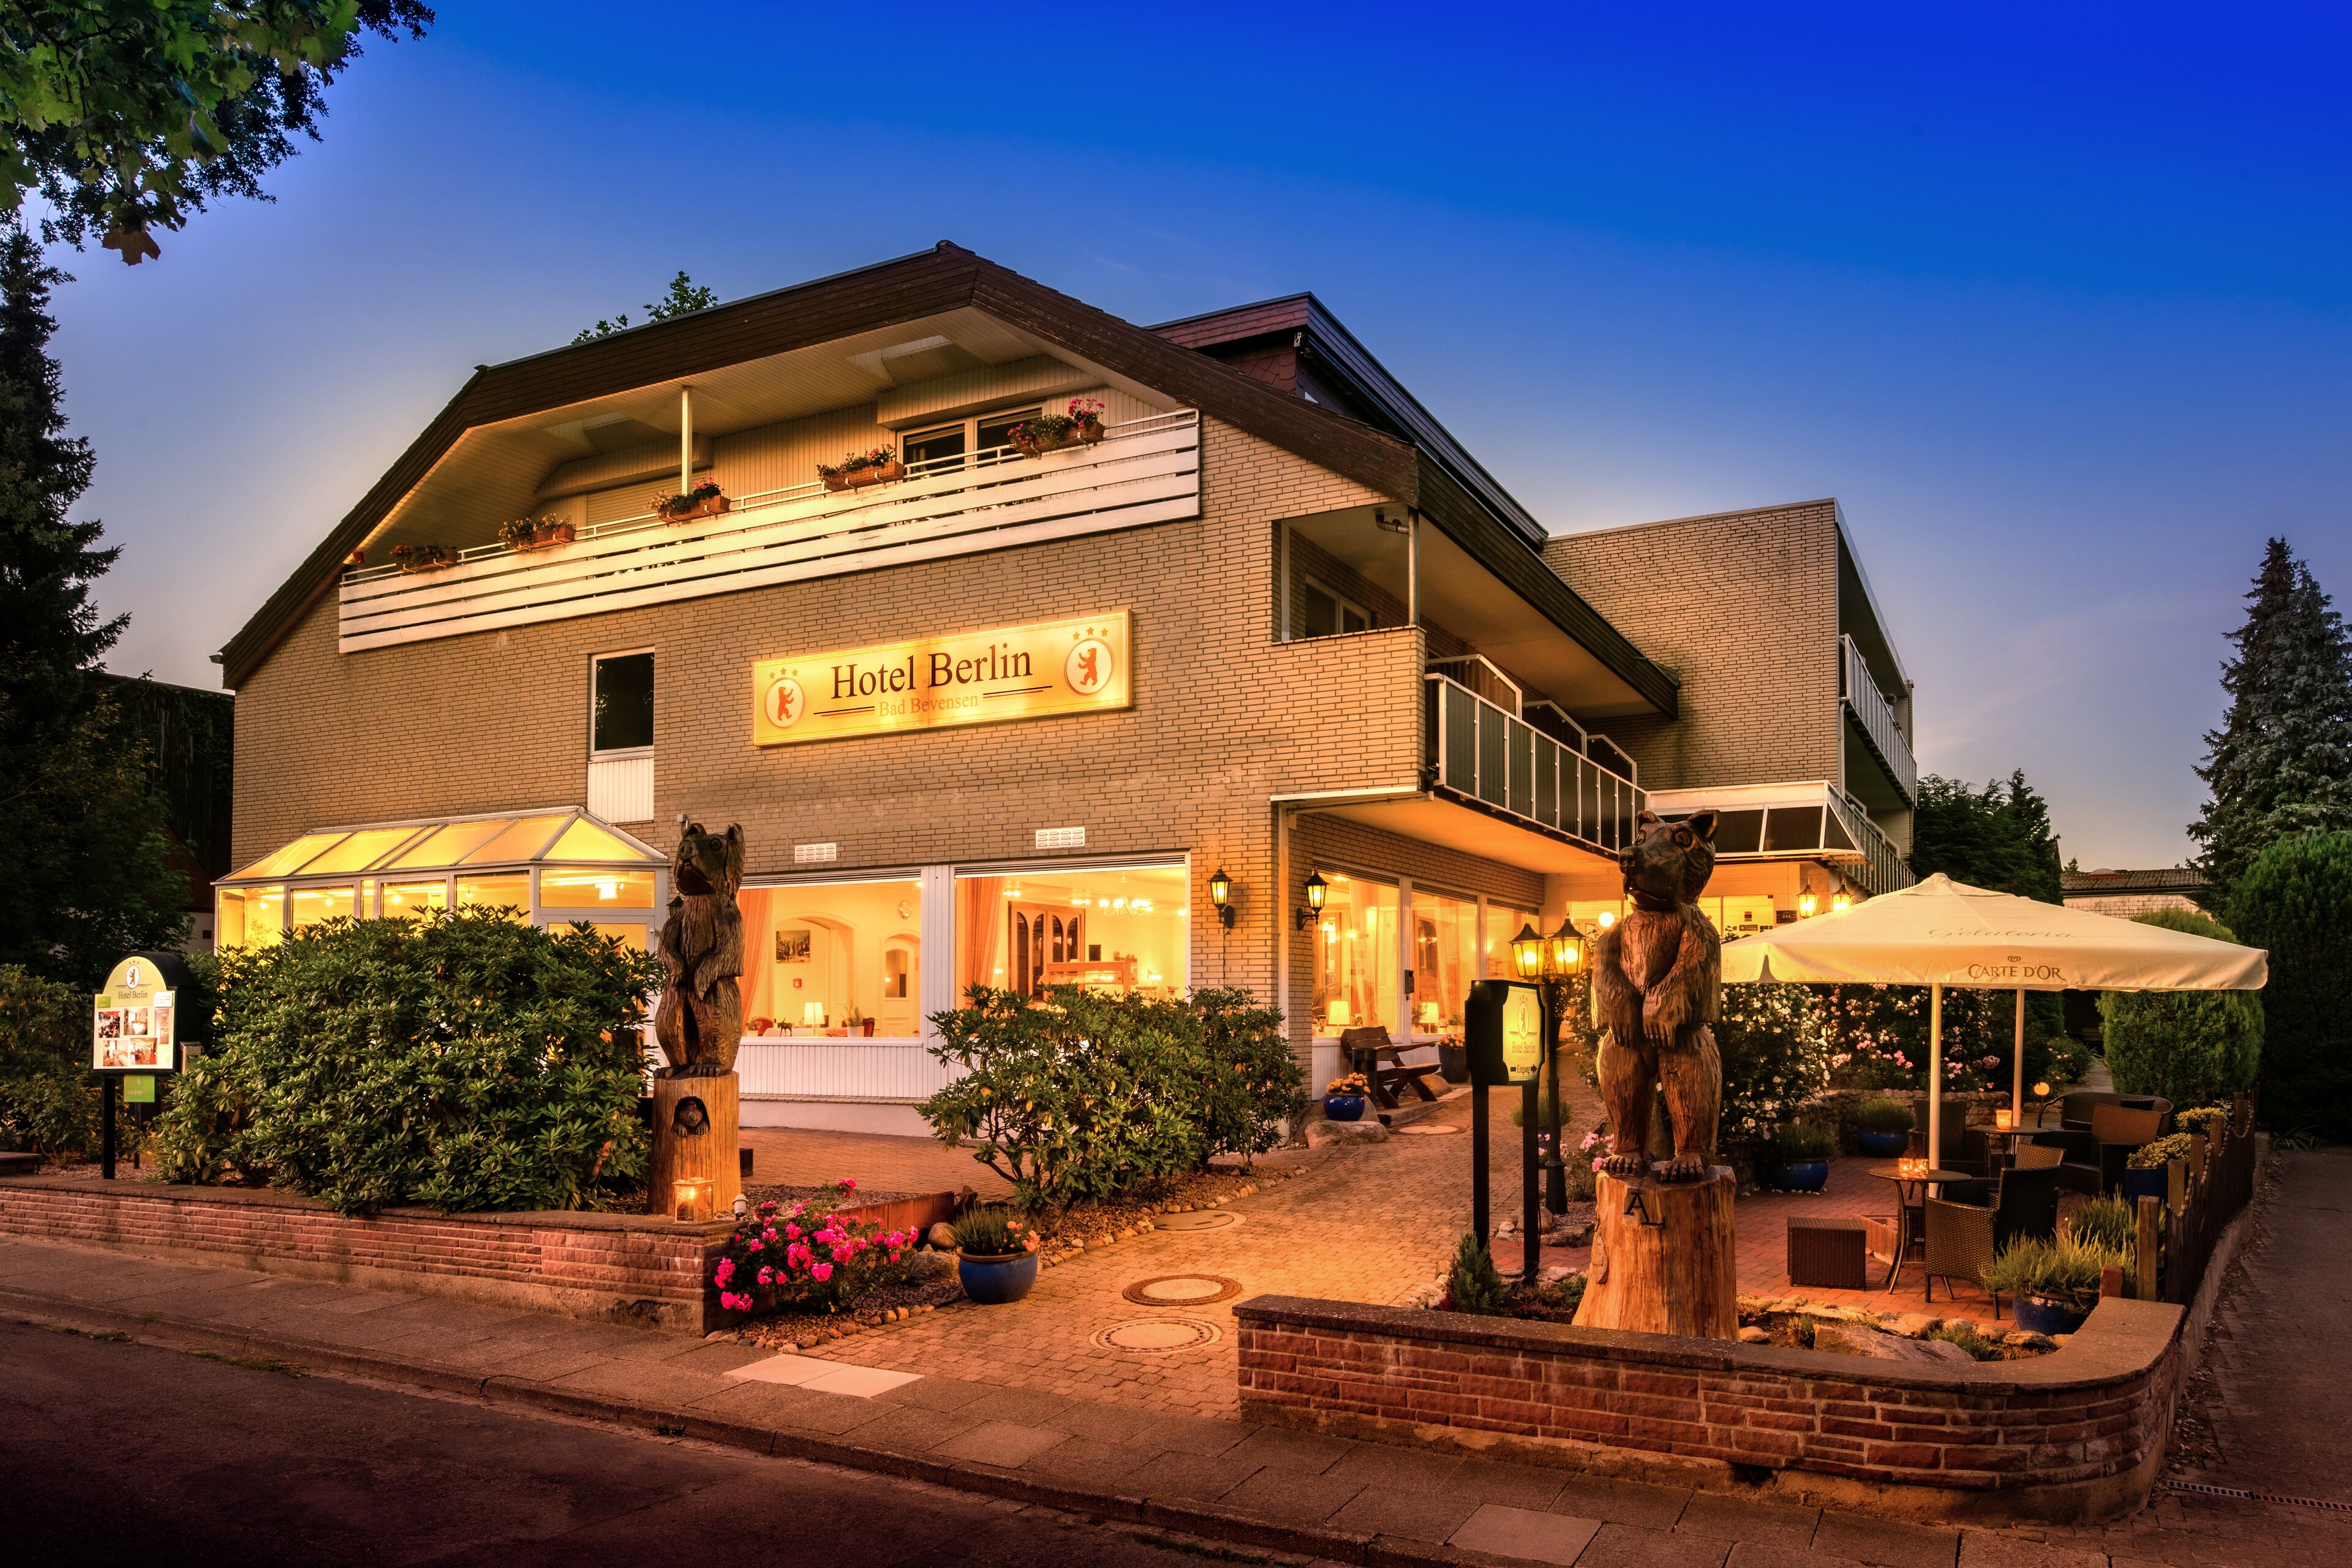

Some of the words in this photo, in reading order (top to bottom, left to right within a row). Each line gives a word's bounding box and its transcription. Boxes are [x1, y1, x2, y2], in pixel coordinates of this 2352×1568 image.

[831, 654, 916, 699] Hotel
[928, 643, 1033, 687] Berlin
[879, 699, 907, 717] Bad
[910, 695, 979, 714] Bevensen
[1928, 928, 2076, 938] Gelateria
[1968, 964, 2018, 978] CARTE
[2024, 965, 2067, 981] D'OR
[1512, 1042, 1523, 1053] Hotel
[1524, 1042, 1535, 1053] Berlin
[1517, 1065, 1530, 1076] Eingang
